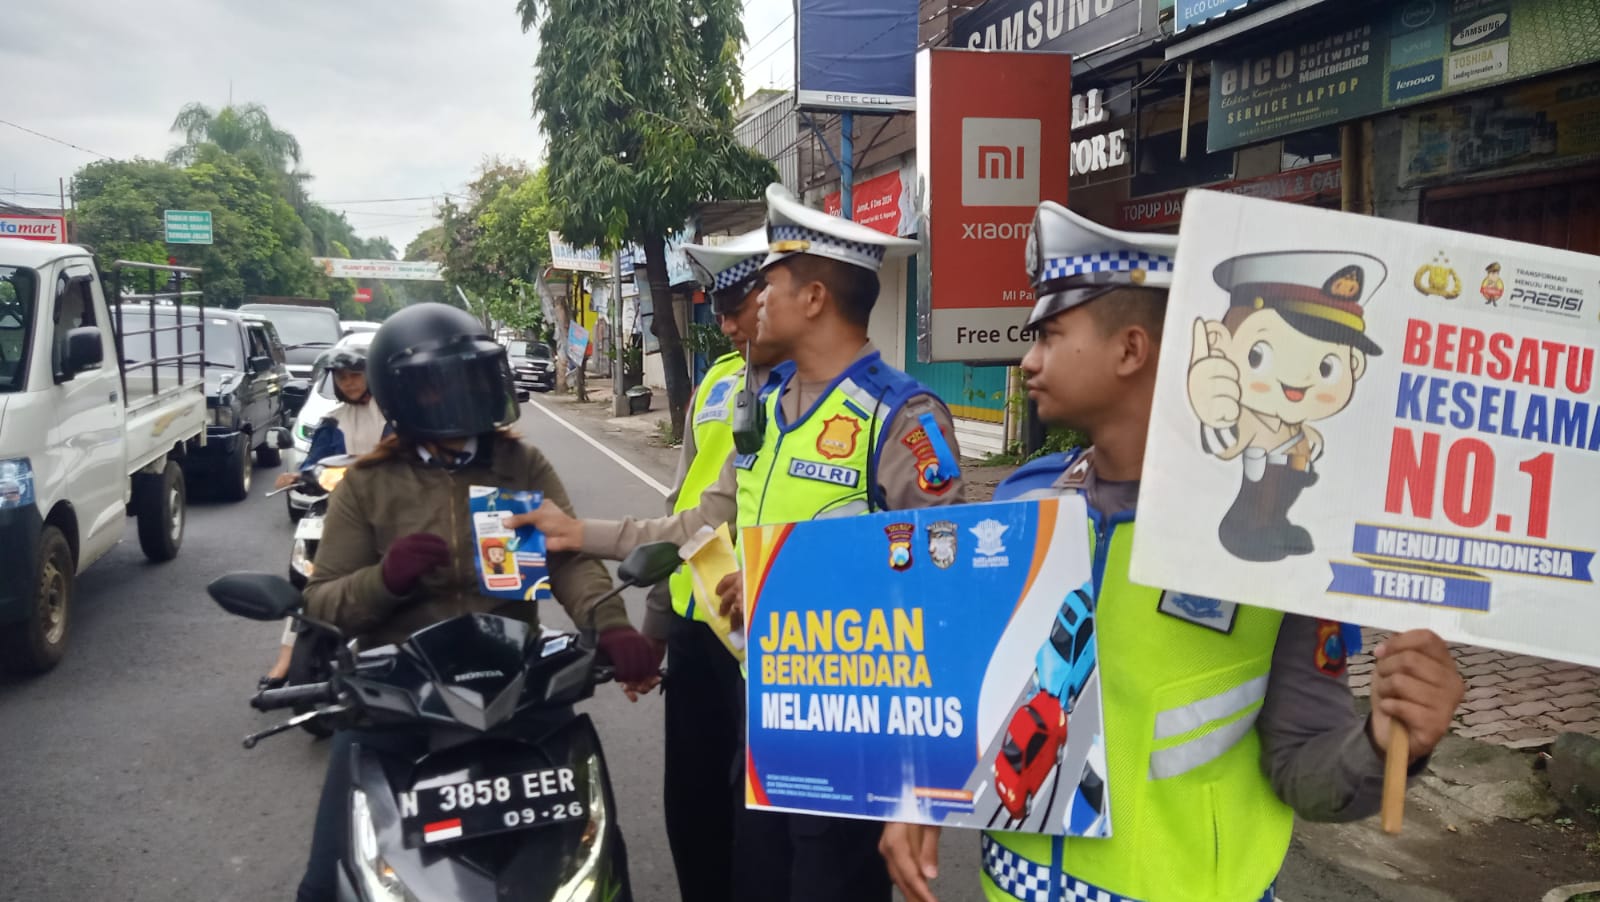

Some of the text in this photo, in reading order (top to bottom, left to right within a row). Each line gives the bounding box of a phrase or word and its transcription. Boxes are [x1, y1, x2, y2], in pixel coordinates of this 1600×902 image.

[1184, 1, 1206, 19] ELCO
[1459, 20, 1501, 39] SAMSUNG
[1298, 54, 1369, 84] Maintenance
[1299, 41, 1370, 71] Software
[1453, 49, 1493, 69] TOSHIBA
[1221, 50, 1295, 96] elco
[1396, 73, 1436, 90] lenovo
[825, 94, 892, 105] FREE CELL
[1071, 88, 1103, 130] LL
[1227, 97, 1289, 124] SERVICE
[1297, 77, 1359, 106] LAPTOP
[1070, 128, 1125, 176] TORE
[1124, 202, 1161, 220] TOPUP
[962, 223, 1032, 240] xiaom
[1515, 279, 1584, 296] MENUJU POLRI YANG
[1516, 268, 1568, 282] TRANSFORMASI
[1003, 291, 1016, 301] MI
[1510, 288, 1583, 312] PRESISI
[957, 327, 1000, 343] Free
[1402, 317, 1595, 395] BERSATU
[794, 462, 851, 483] POLRI
[1385, 426, 1555, 539] NO.1
[1376, 529, 1574, 577] MENUJU INDONESIA
[1373, 570, 1446, 603] TERTIB
[760, 607, 925, 652] JANGAN
[454, 670, 505, 682] HONDA
[761, 654, 933, 688] BERKENDARA
[762, 692, 964, 739] MELAWAN ARUS
[399, 768, 576, 818] N 3858 EER
